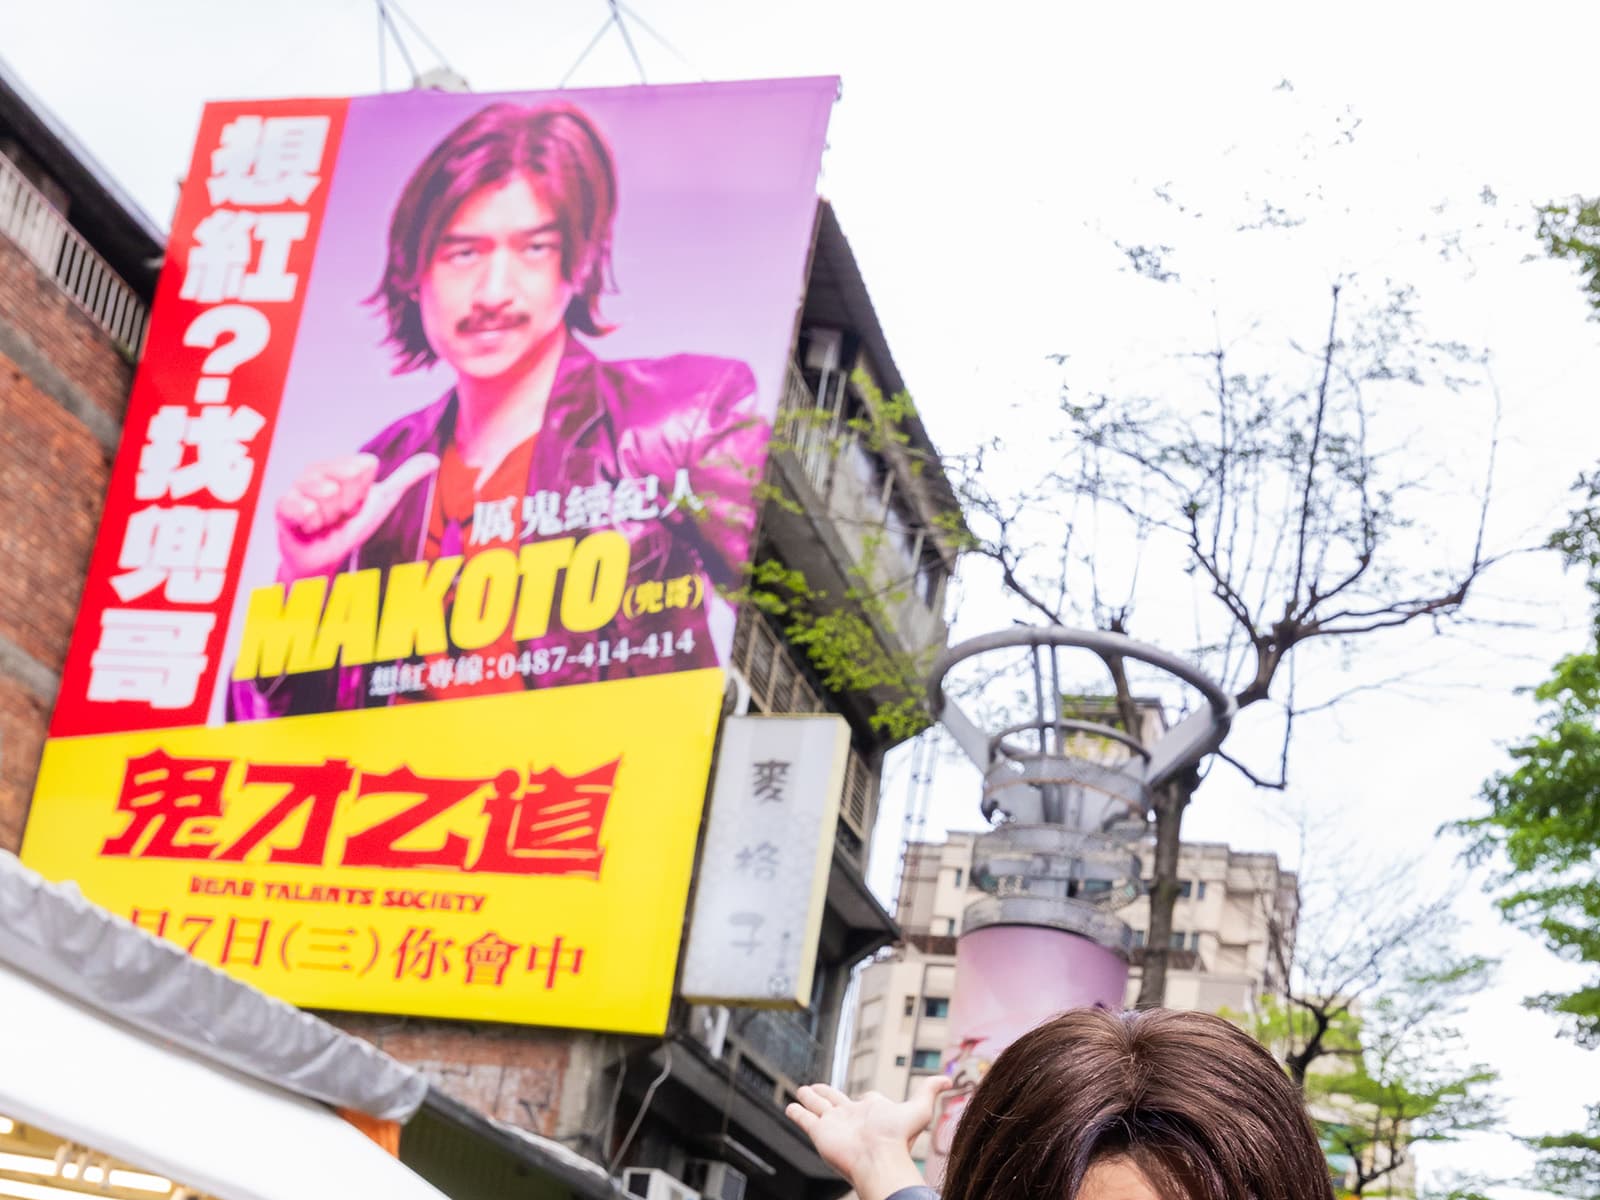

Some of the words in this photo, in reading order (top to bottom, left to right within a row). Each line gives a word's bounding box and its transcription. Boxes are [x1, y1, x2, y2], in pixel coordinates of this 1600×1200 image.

[469, 468, 705, 546] 厲鬼經紀人
[232, 530, 631, 682] MAKOTO
[98, 747, 624, 881] 鬼才之道
[264, 883, 374, 905] TALENTS
[381, 890, 485, 913] SOCIETY
